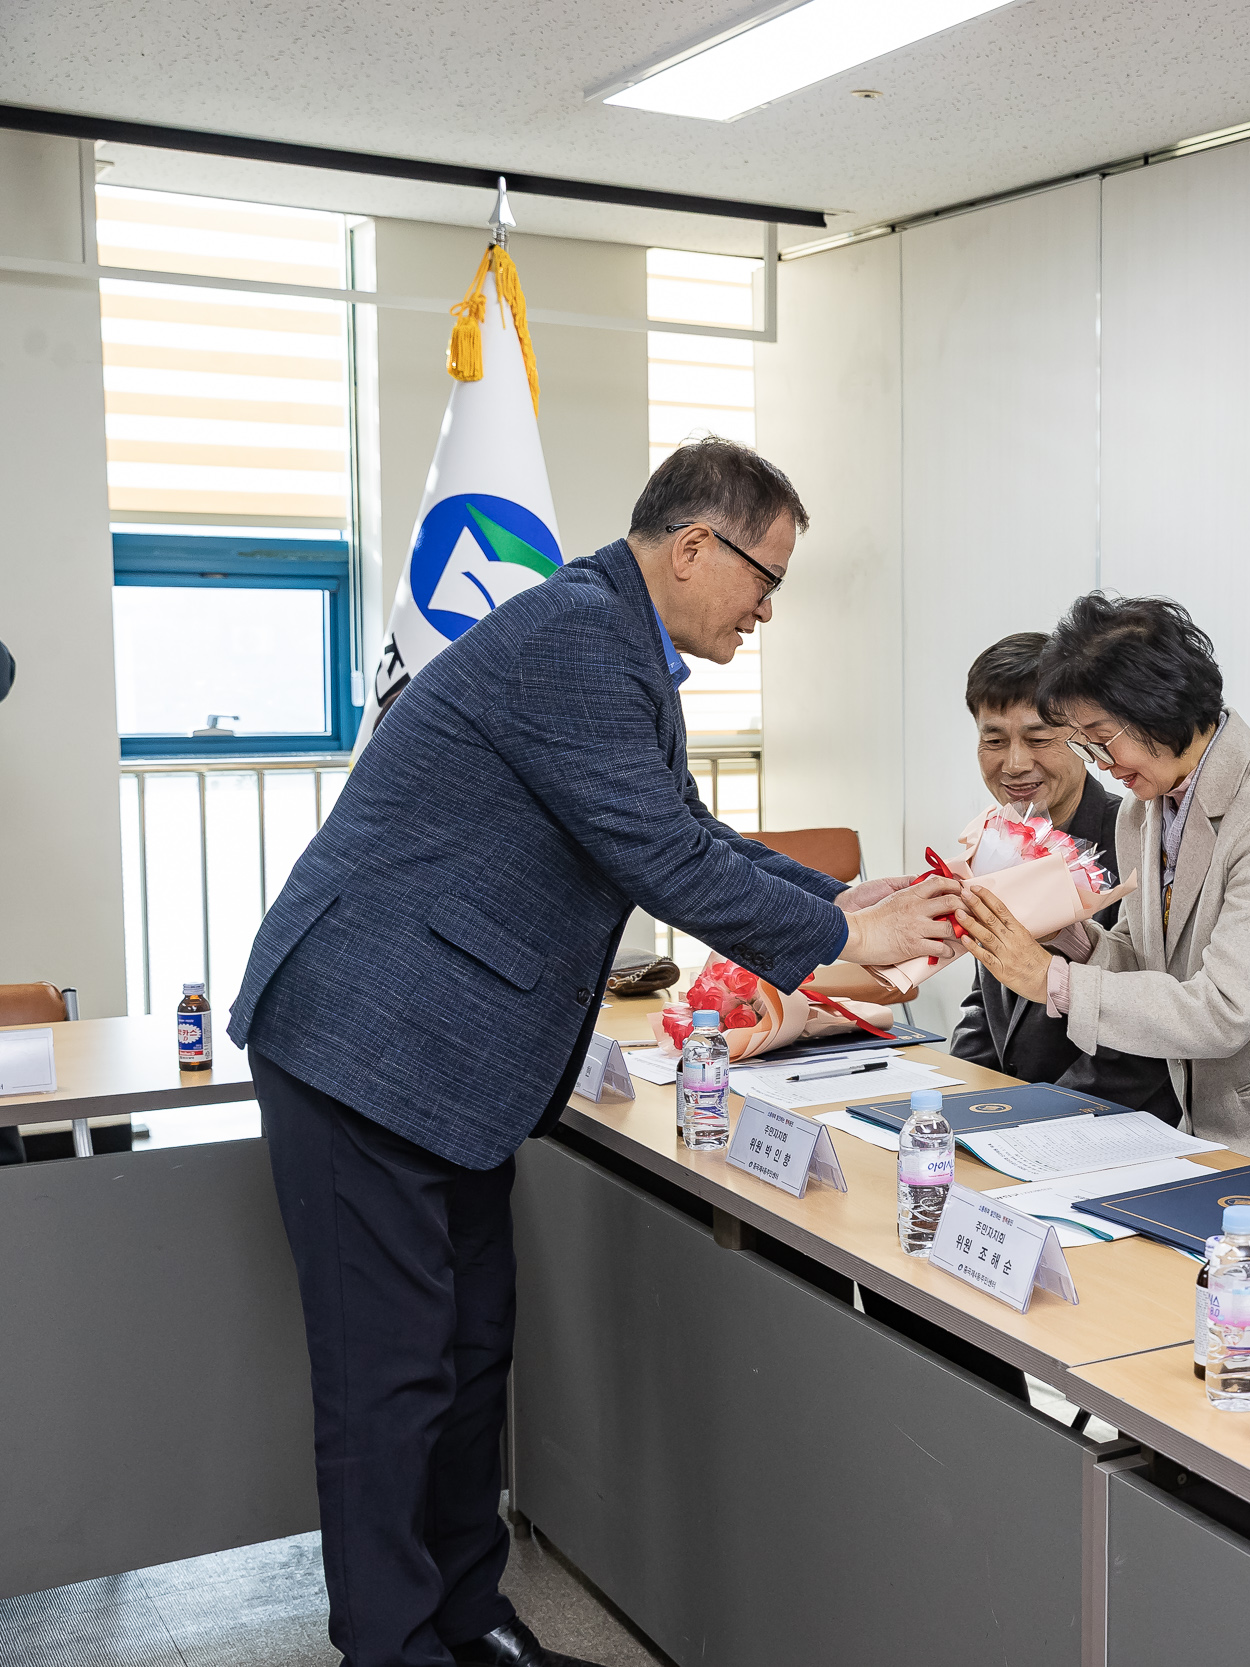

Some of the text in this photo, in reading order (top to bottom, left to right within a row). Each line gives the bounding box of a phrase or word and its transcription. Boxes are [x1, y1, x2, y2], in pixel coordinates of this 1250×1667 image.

[749, 1137, 764, 1154] 위원
[956, 1234, 973, 1255] 위원
[977, 1246, 989, 1262] 조
[1002, 1259, 1012, 1276] 순
